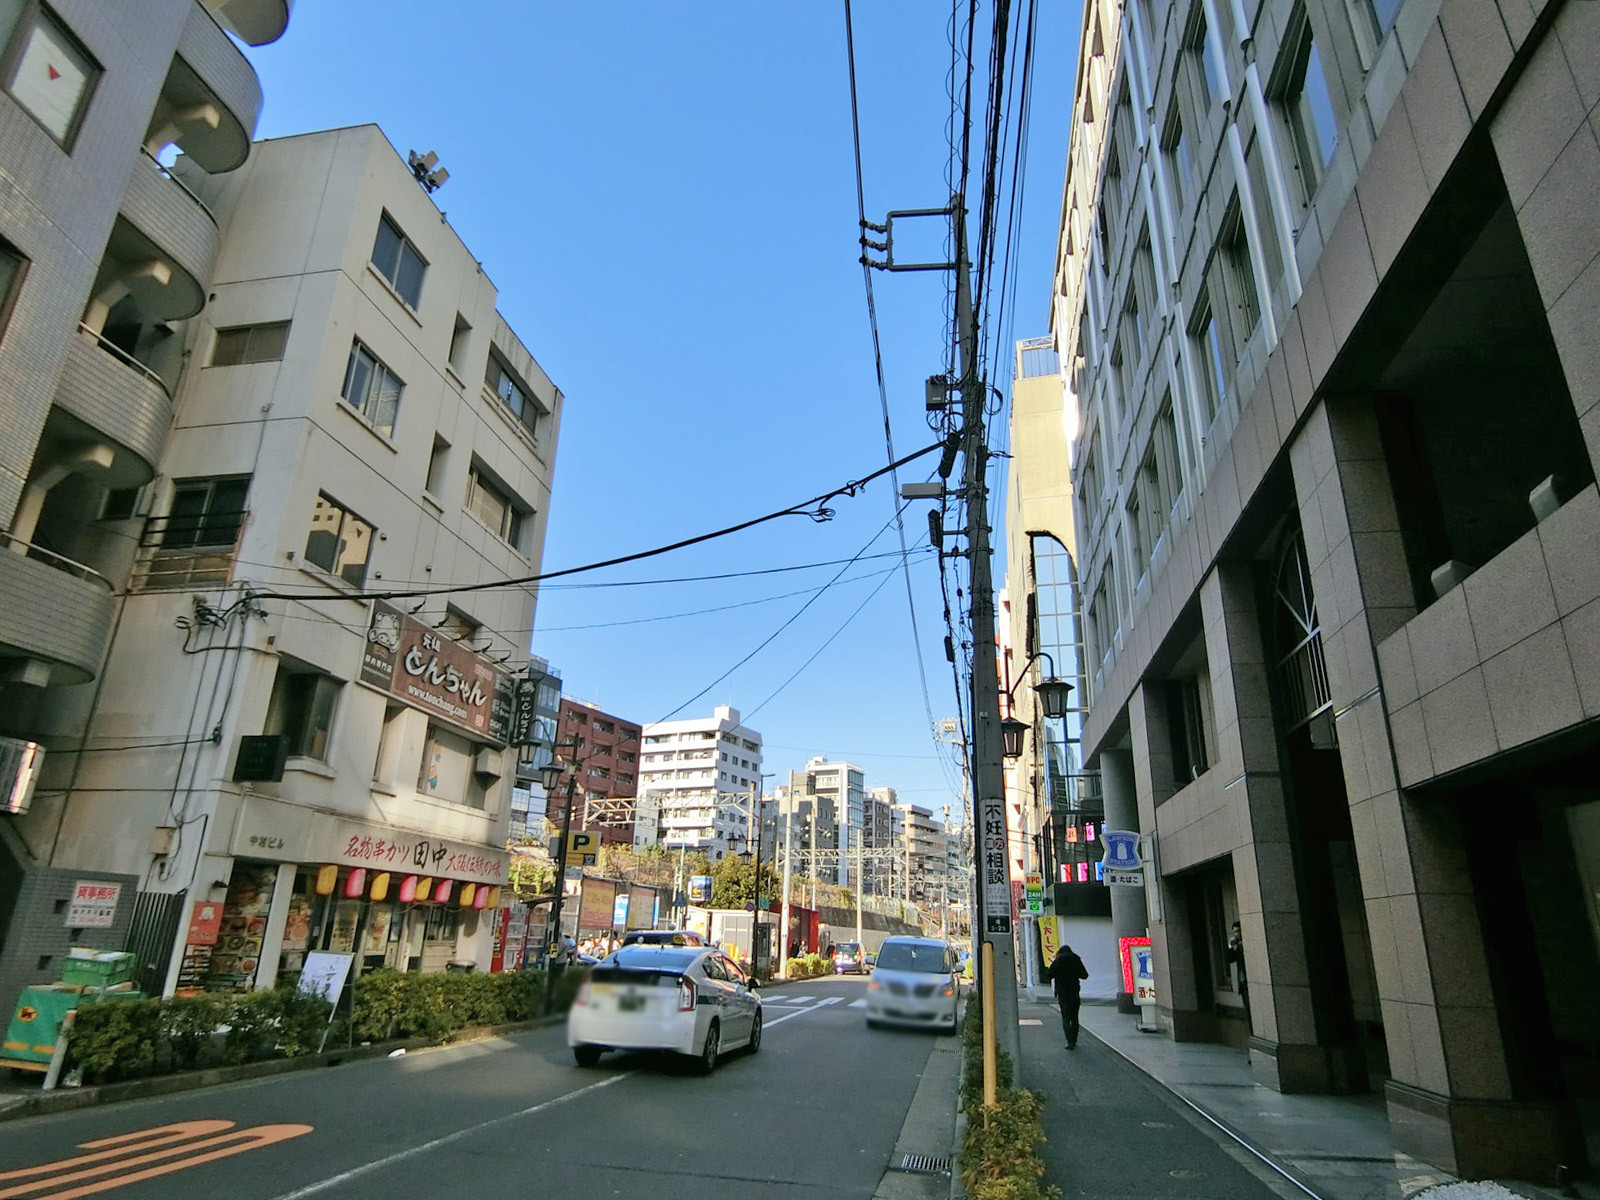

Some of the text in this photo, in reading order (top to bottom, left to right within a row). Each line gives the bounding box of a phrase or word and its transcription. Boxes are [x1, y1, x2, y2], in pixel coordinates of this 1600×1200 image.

[404, 645, 488, 708] とんちゃん
[413, 841, 448, 874] 田中
[573, 834, 591, 851] P
